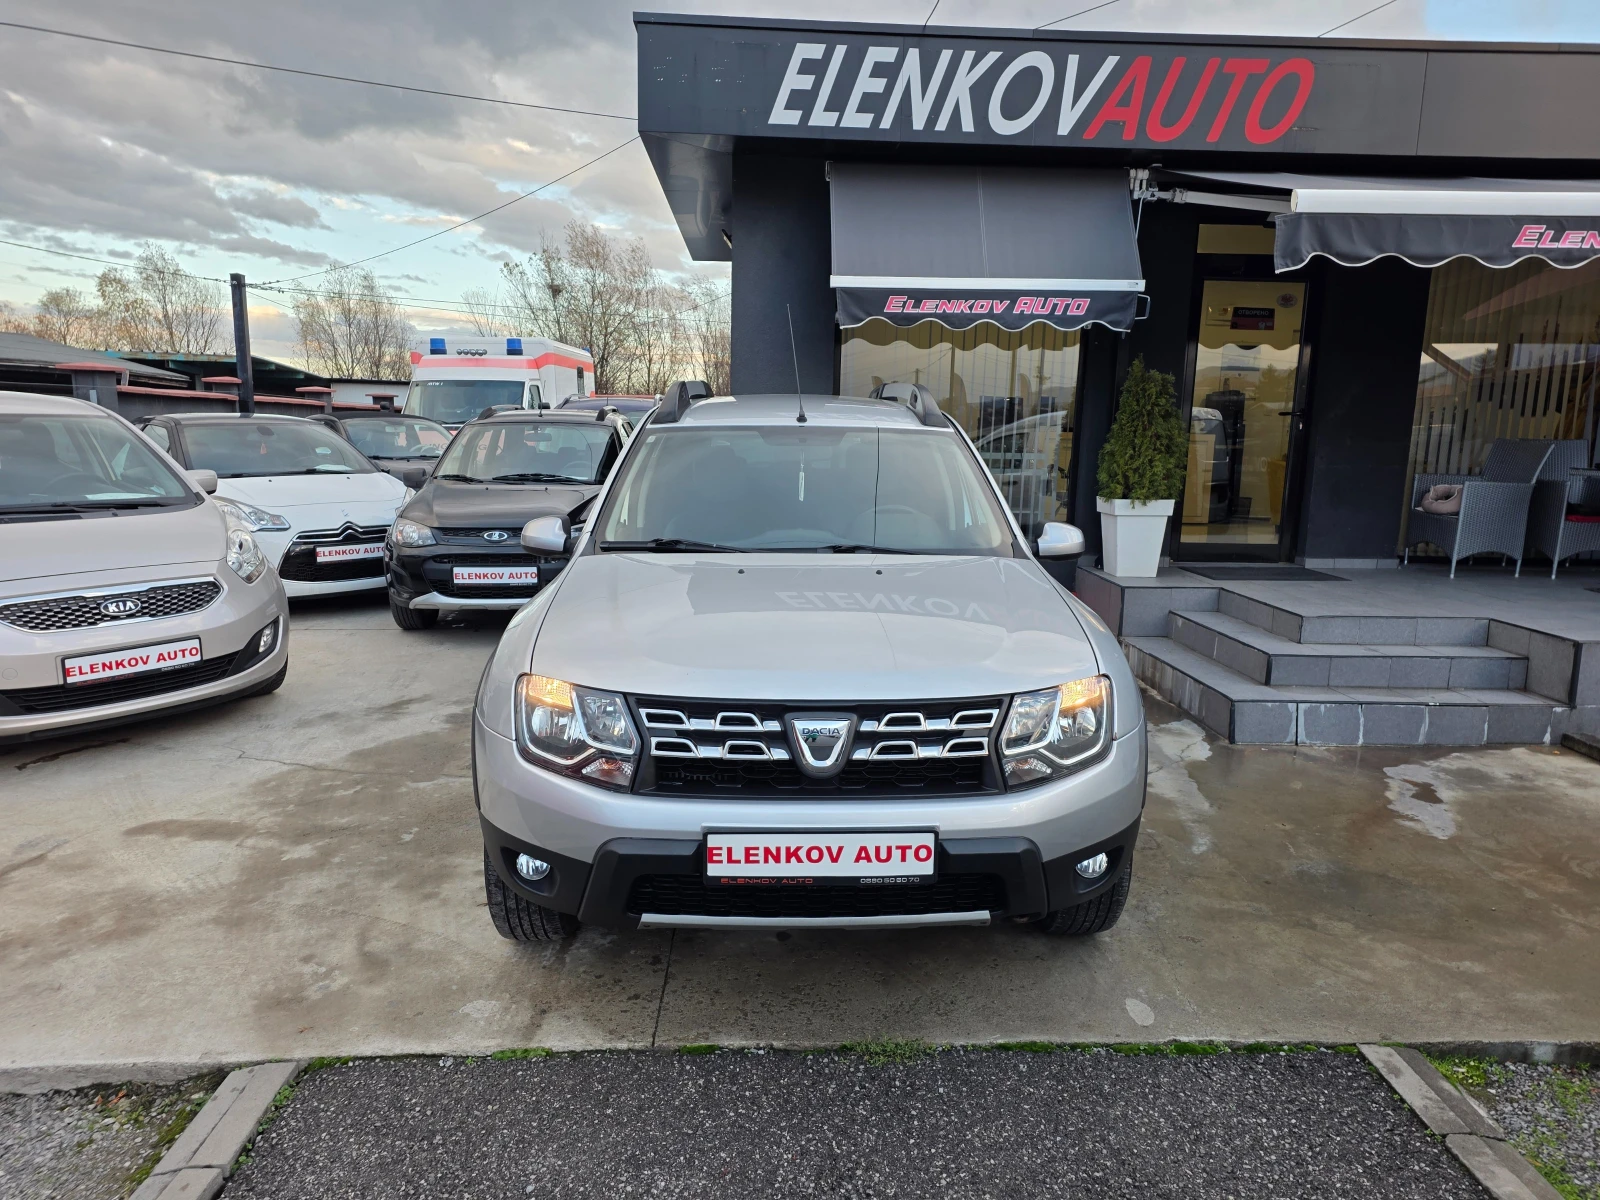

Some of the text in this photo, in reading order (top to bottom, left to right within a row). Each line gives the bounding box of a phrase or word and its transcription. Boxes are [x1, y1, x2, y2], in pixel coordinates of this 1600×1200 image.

[884, 295, 1090, 316] ELENKOV AUTO
[315, 548, 361, 558] ELENKOV
[454, 571, 538, 580] ELENKOV AUTO
[107, 601, 136, 613] KIA
[65, 646, 199, 678] ELENKOV AUTO
[802, 727, 841, 736] DACIA
[707, 844, 932, 864] ELENKOV AUTO
